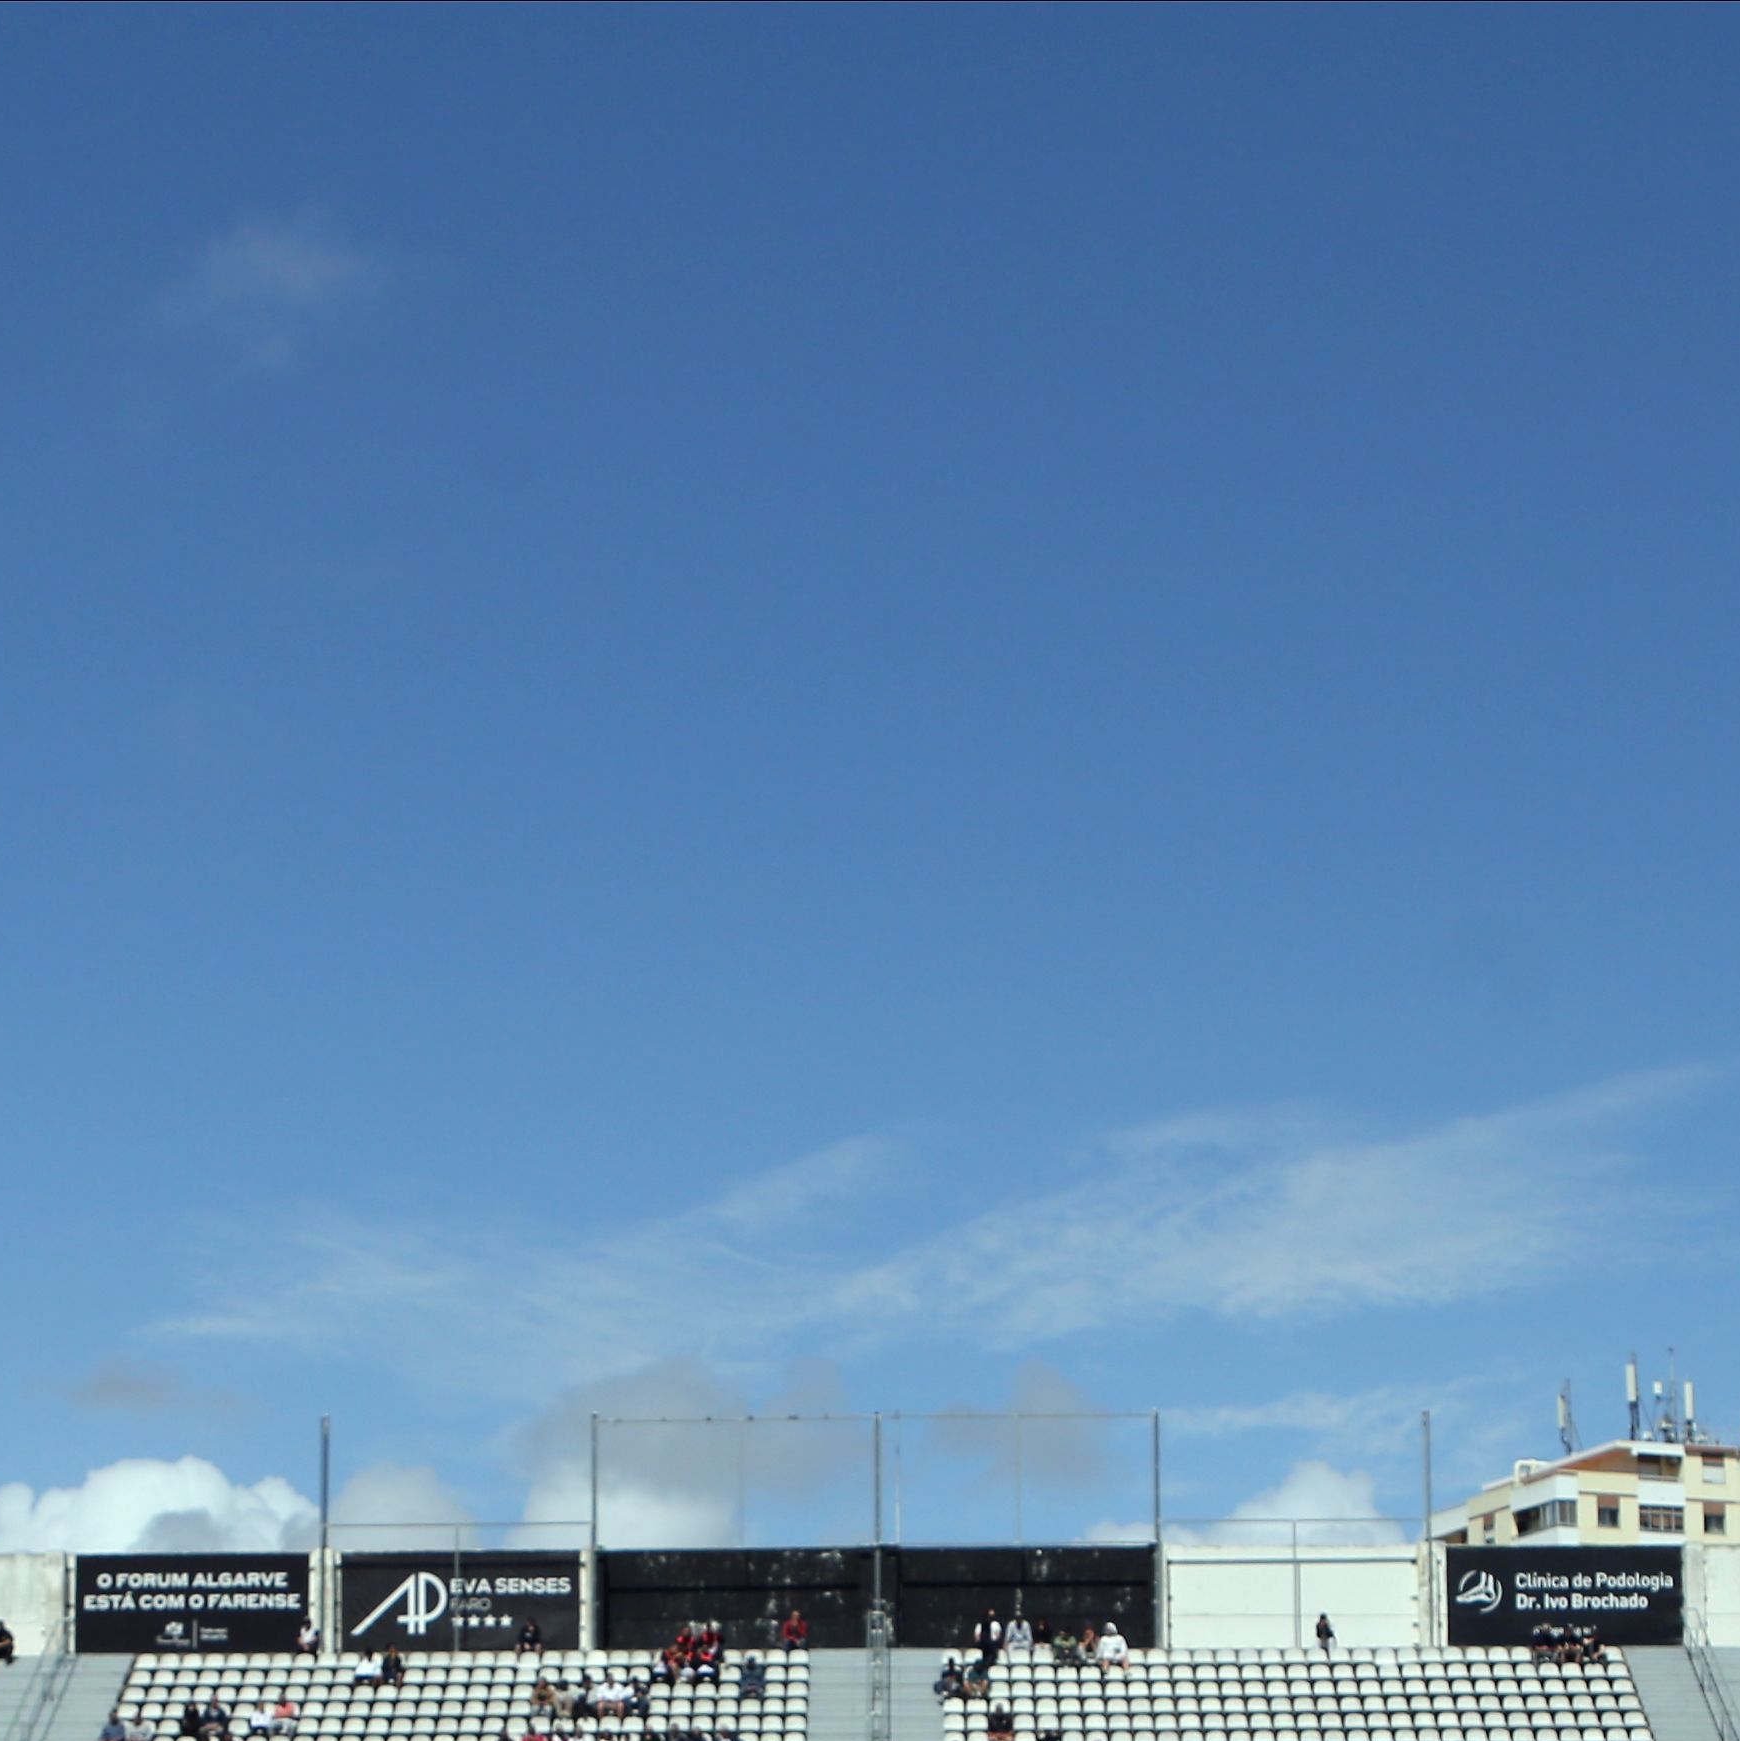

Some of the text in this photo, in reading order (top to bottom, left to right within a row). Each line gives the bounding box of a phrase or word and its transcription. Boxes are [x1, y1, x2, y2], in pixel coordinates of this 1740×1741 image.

[96, 1572, 288, 1588] O FORUM ALGARVE
[449, 1577, 572, 1594] EVA SENSES
[1572, 1573, 1593, 1589] de
[1596, 1572, 1675, 1593] Podologia
[83, 1591, 302, 1611] ESTÁ COM O FARENSE
[1515, 1593, 1650, 1610] Dr. Ivo Brochado
